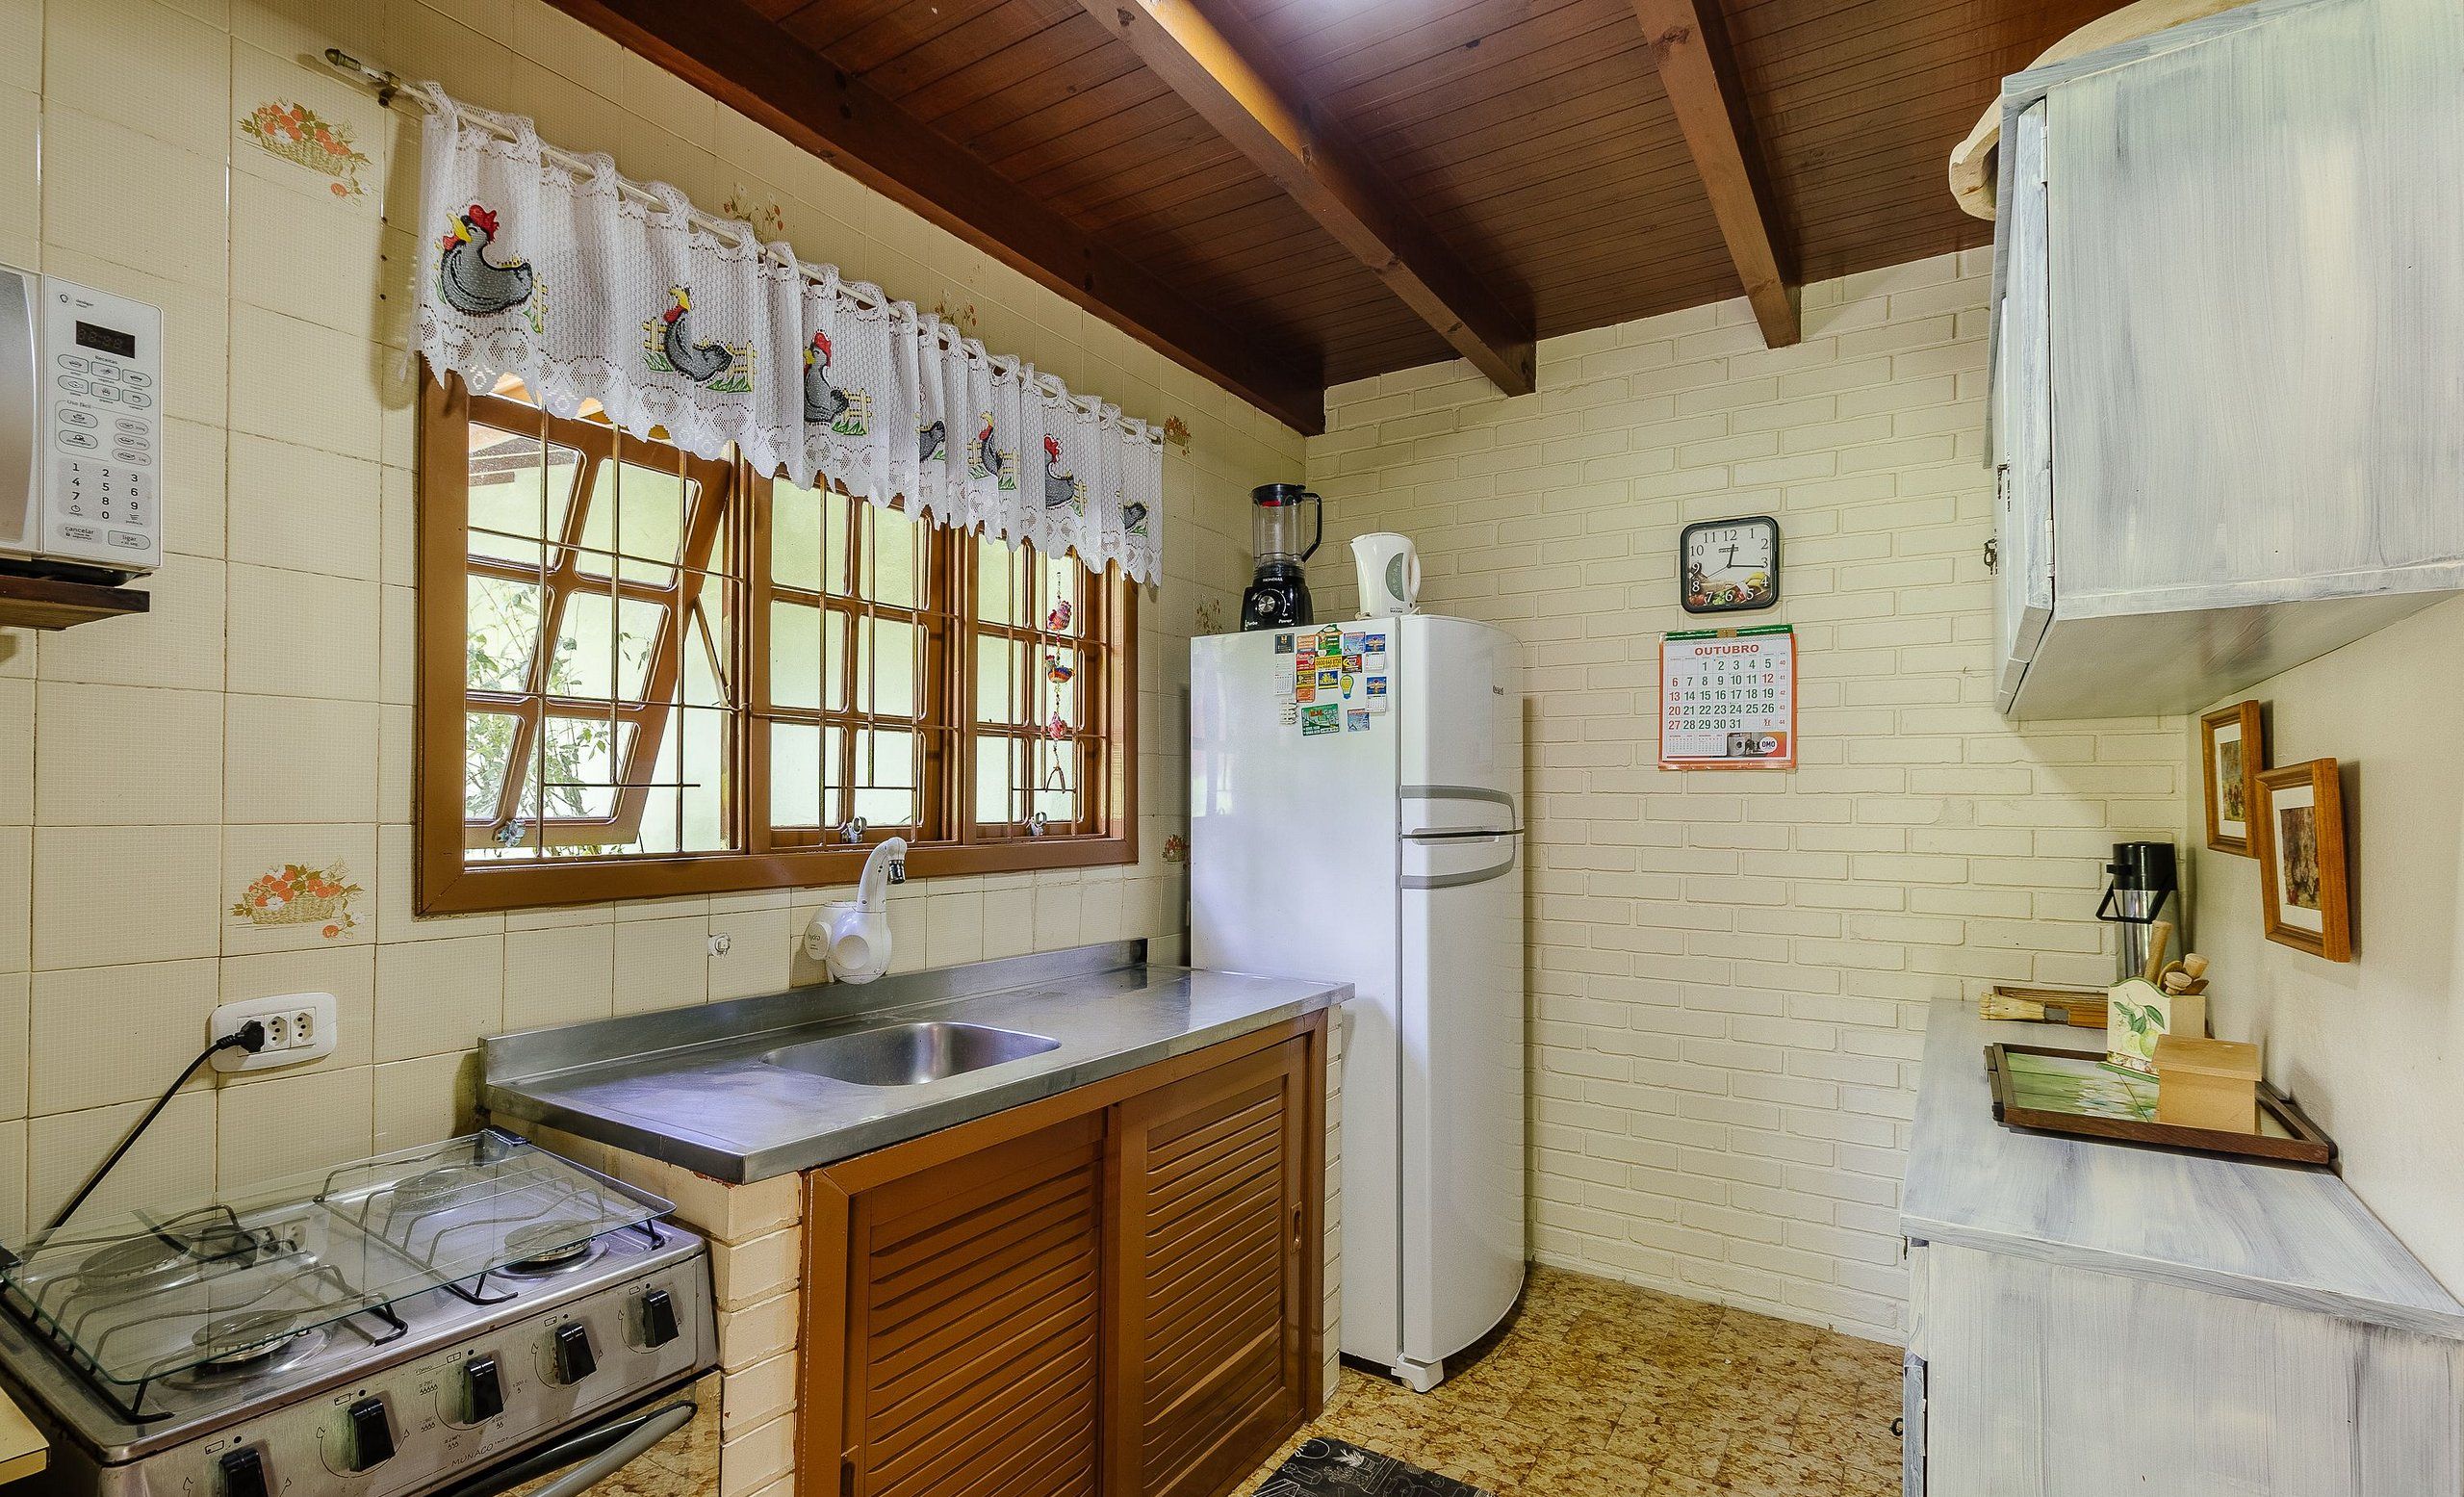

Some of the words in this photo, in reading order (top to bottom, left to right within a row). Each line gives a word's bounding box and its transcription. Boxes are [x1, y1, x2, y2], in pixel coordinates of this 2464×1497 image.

[73, 463, 79, 471] 1
[1704, 532, 1715, 543] 11
[1724, 529, 1737, 541] 12
[1750, 528, 1754, 539] 1
[1761, 539, 1768, 549] 2
[1691, 545, 1704, 556] 10
[1761, 557, 1768, 568] 3
[1692, 563, 1700, 574] 9
[1692, 580, 1699, 592] 8
[1760, 576, 1768, 587] 4
[1706, 592, 1713, 602] 7
[1725, 591, 1733, 601] 6
[1747, 589, 1754, 600] 5
[1695, 644, 1759, 655] OUTUBRO
[1702, 662, 1707, 671] 1
[1718, 661, 1724, 670] 2
[1733, 660, 1739, 670] 3
[1749, 660, 1756, 669] 4
[1765, 659, 1771, 668] 5
[1672, 678, 1678, 687] 6
[1687, 677, 1693, 686] 7
[1702, 676, 1708, 686] 8
[1718, 676, 1723, 685] 9
[1731, 675, 1742, 685] 10
[1747, 675, 1756, 684] 11
[1762, 674, 1773, 683] 12
[1670, 692, 1680, 701] 13
[1684, 692, 1695, 701] 14
[1700, 691, 1711, 700] 15
[1715, 690, 1726, 699] 16
[1731, 690, 1742, 699] 17
[1746, 689, 1757, 698] 18
[1762, 688, 1773, 698] 19
[1669, 706, 1681, 715] 20
[1684, 706, 1694, 715] 21
[1699, 705, 1711, 714] 22
[1714, 705, 1726, 714] 23
[1730, 704, 1742, 714] 24
[1746, 704, 1758, 713] 25
[1761, 704, 1774, 713] 26
[1669, 721, 1680, 730] 27
[1683, 720, 1695, 729] 28
[1699, 720, 1711, 729] 29
[1714, 720, 1726, 728] 30
[1729, 719, 1741, 728] 31
